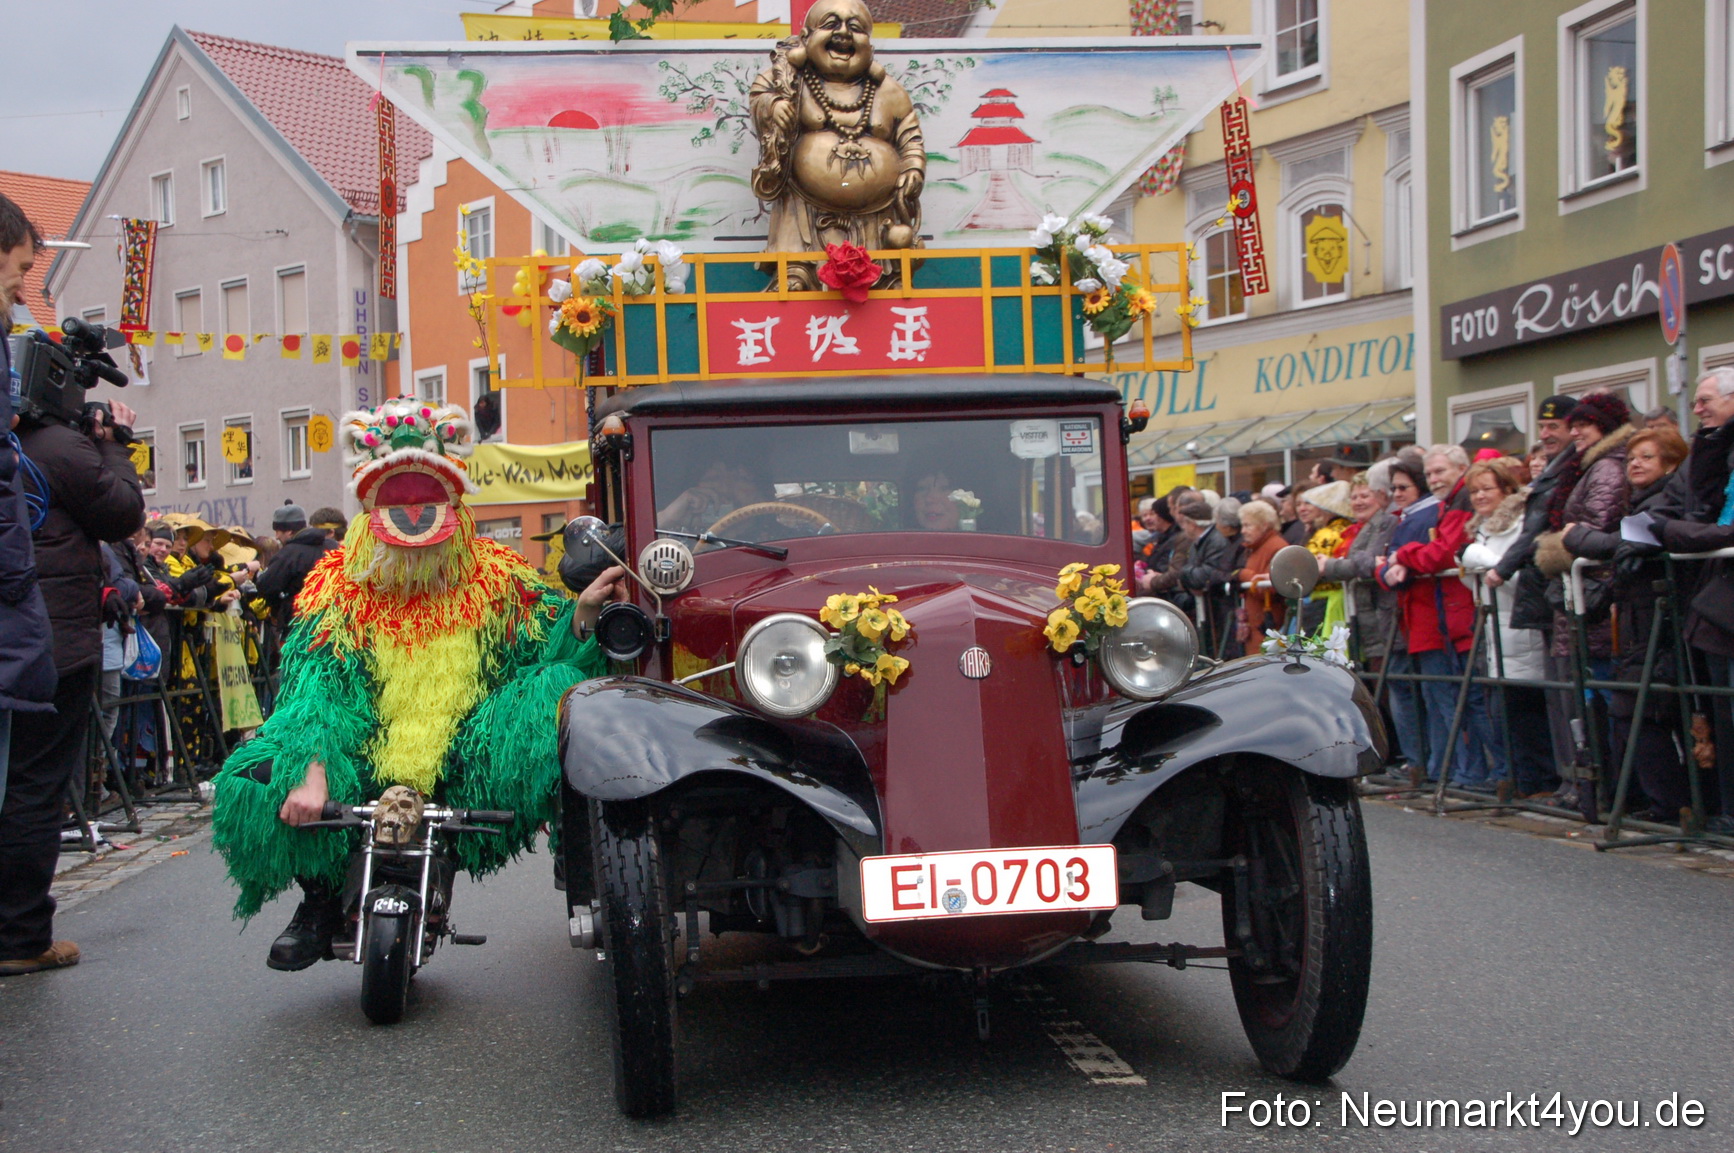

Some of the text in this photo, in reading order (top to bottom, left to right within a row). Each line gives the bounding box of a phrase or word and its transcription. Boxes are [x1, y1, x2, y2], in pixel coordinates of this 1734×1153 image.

[1451, 243, 1734, 345] FOTO Rösch SC
[355, 290, 369, 412] UHREN S
[1100, 359, 1217, 420] TOLL
[1019, 431, 1048, 440] VISITOR
[960, 646, 991, 678] TATRA
[890, 856, 1091, 911] EI-0703
